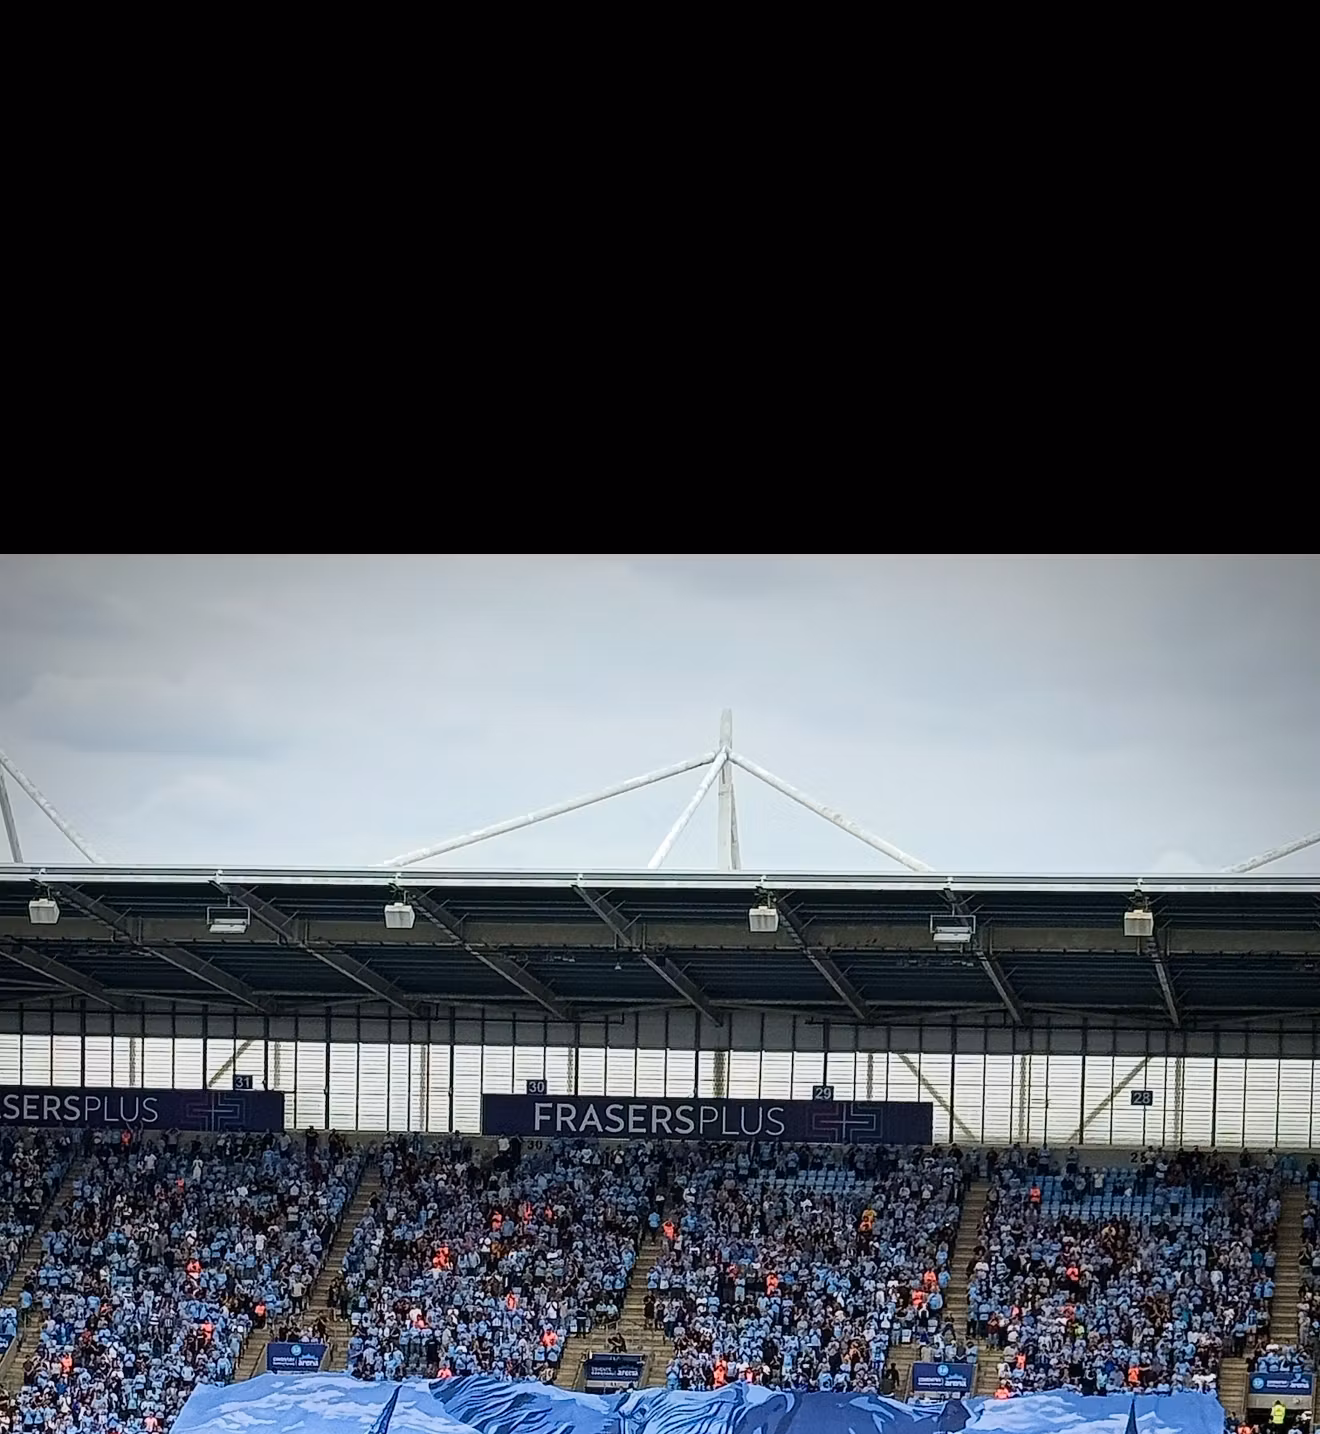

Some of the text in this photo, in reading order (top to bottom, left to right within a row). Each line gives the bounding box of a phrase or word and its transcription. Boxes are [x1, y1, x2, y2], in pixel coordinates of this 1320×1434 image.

[235, 1076, 250, 1088] 31
[528, 1081, 545, 1093] 30
[815, 1087, 832, 1099] 29
[1133, 1092, 1150, 1104] 28
[0, 1094, 159, 1123] SERSPLUS
